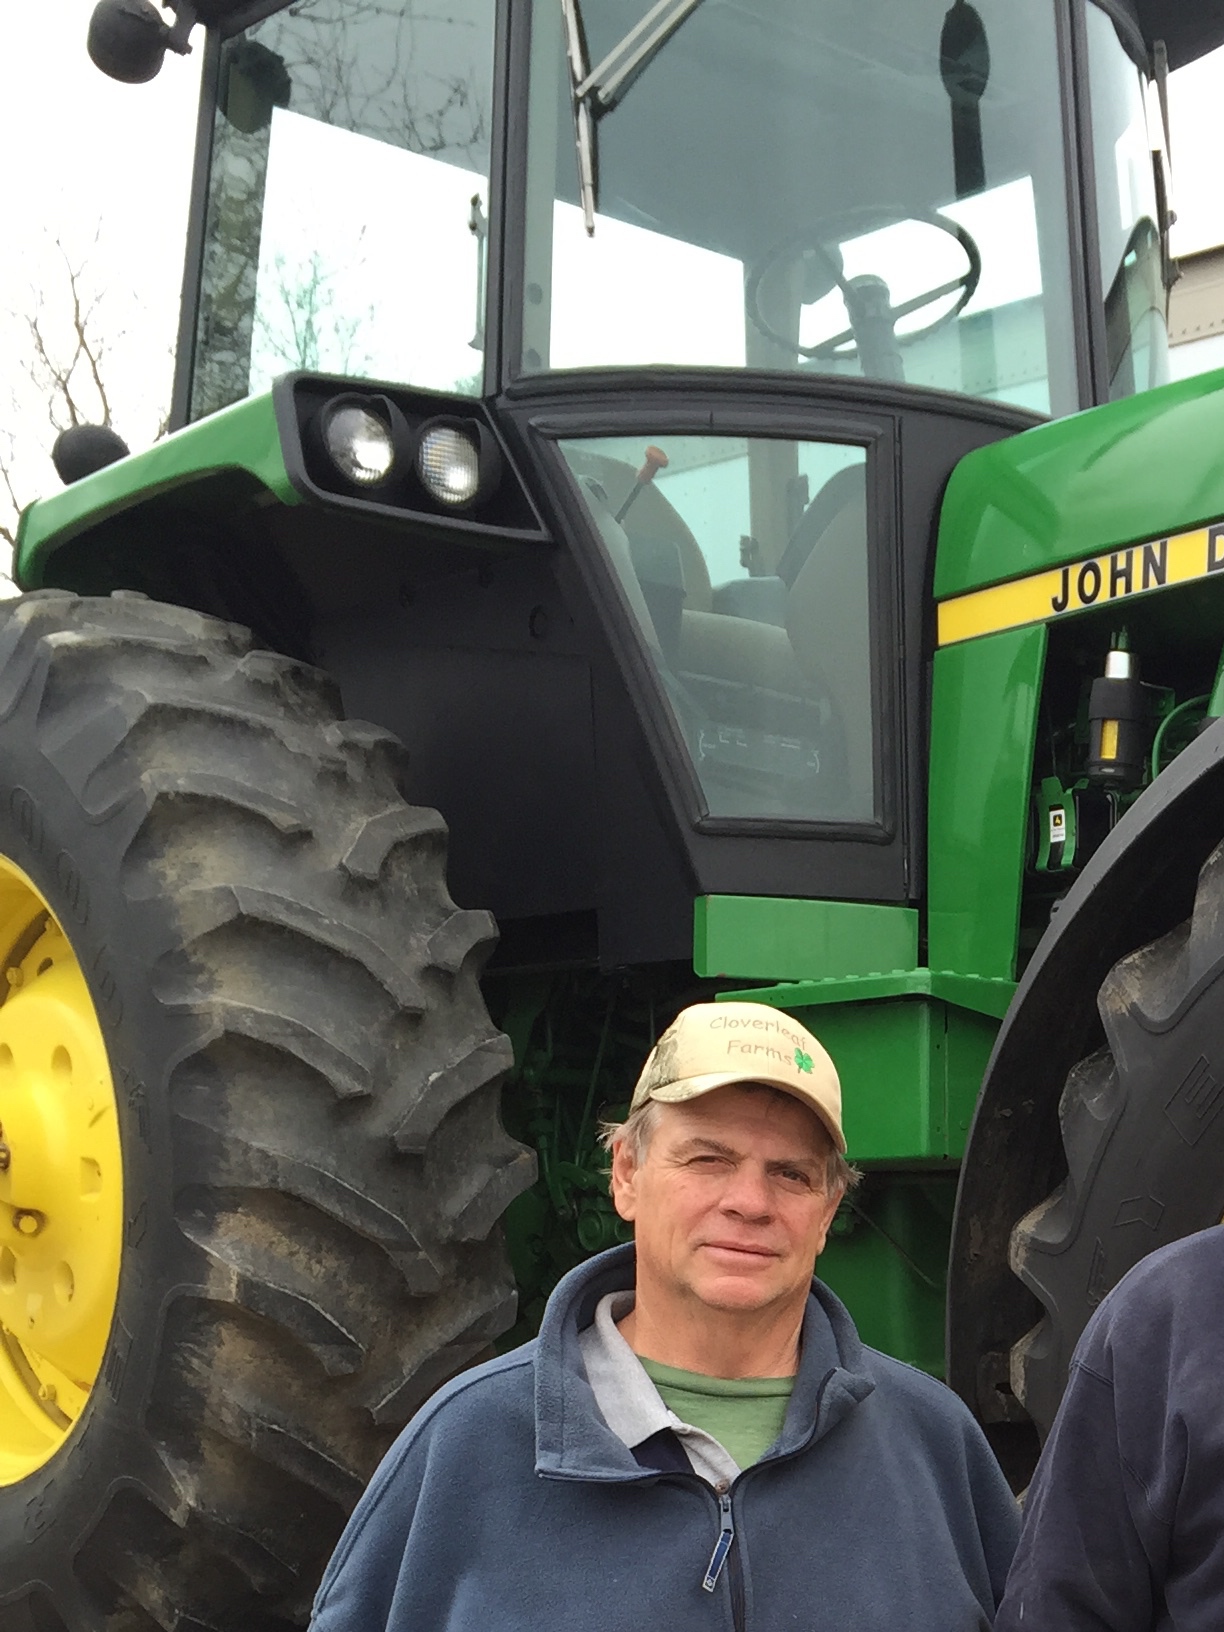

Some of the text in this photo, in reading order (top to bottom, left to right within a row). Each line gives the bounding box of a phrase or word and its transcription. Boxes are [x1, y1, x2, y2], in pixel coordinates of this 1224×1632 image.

[1051, 539, 1168, 613] JOHN
[709, 1015, 807, 1051] Cloverleaf
[726, 1039, 793, 1067] Farms
